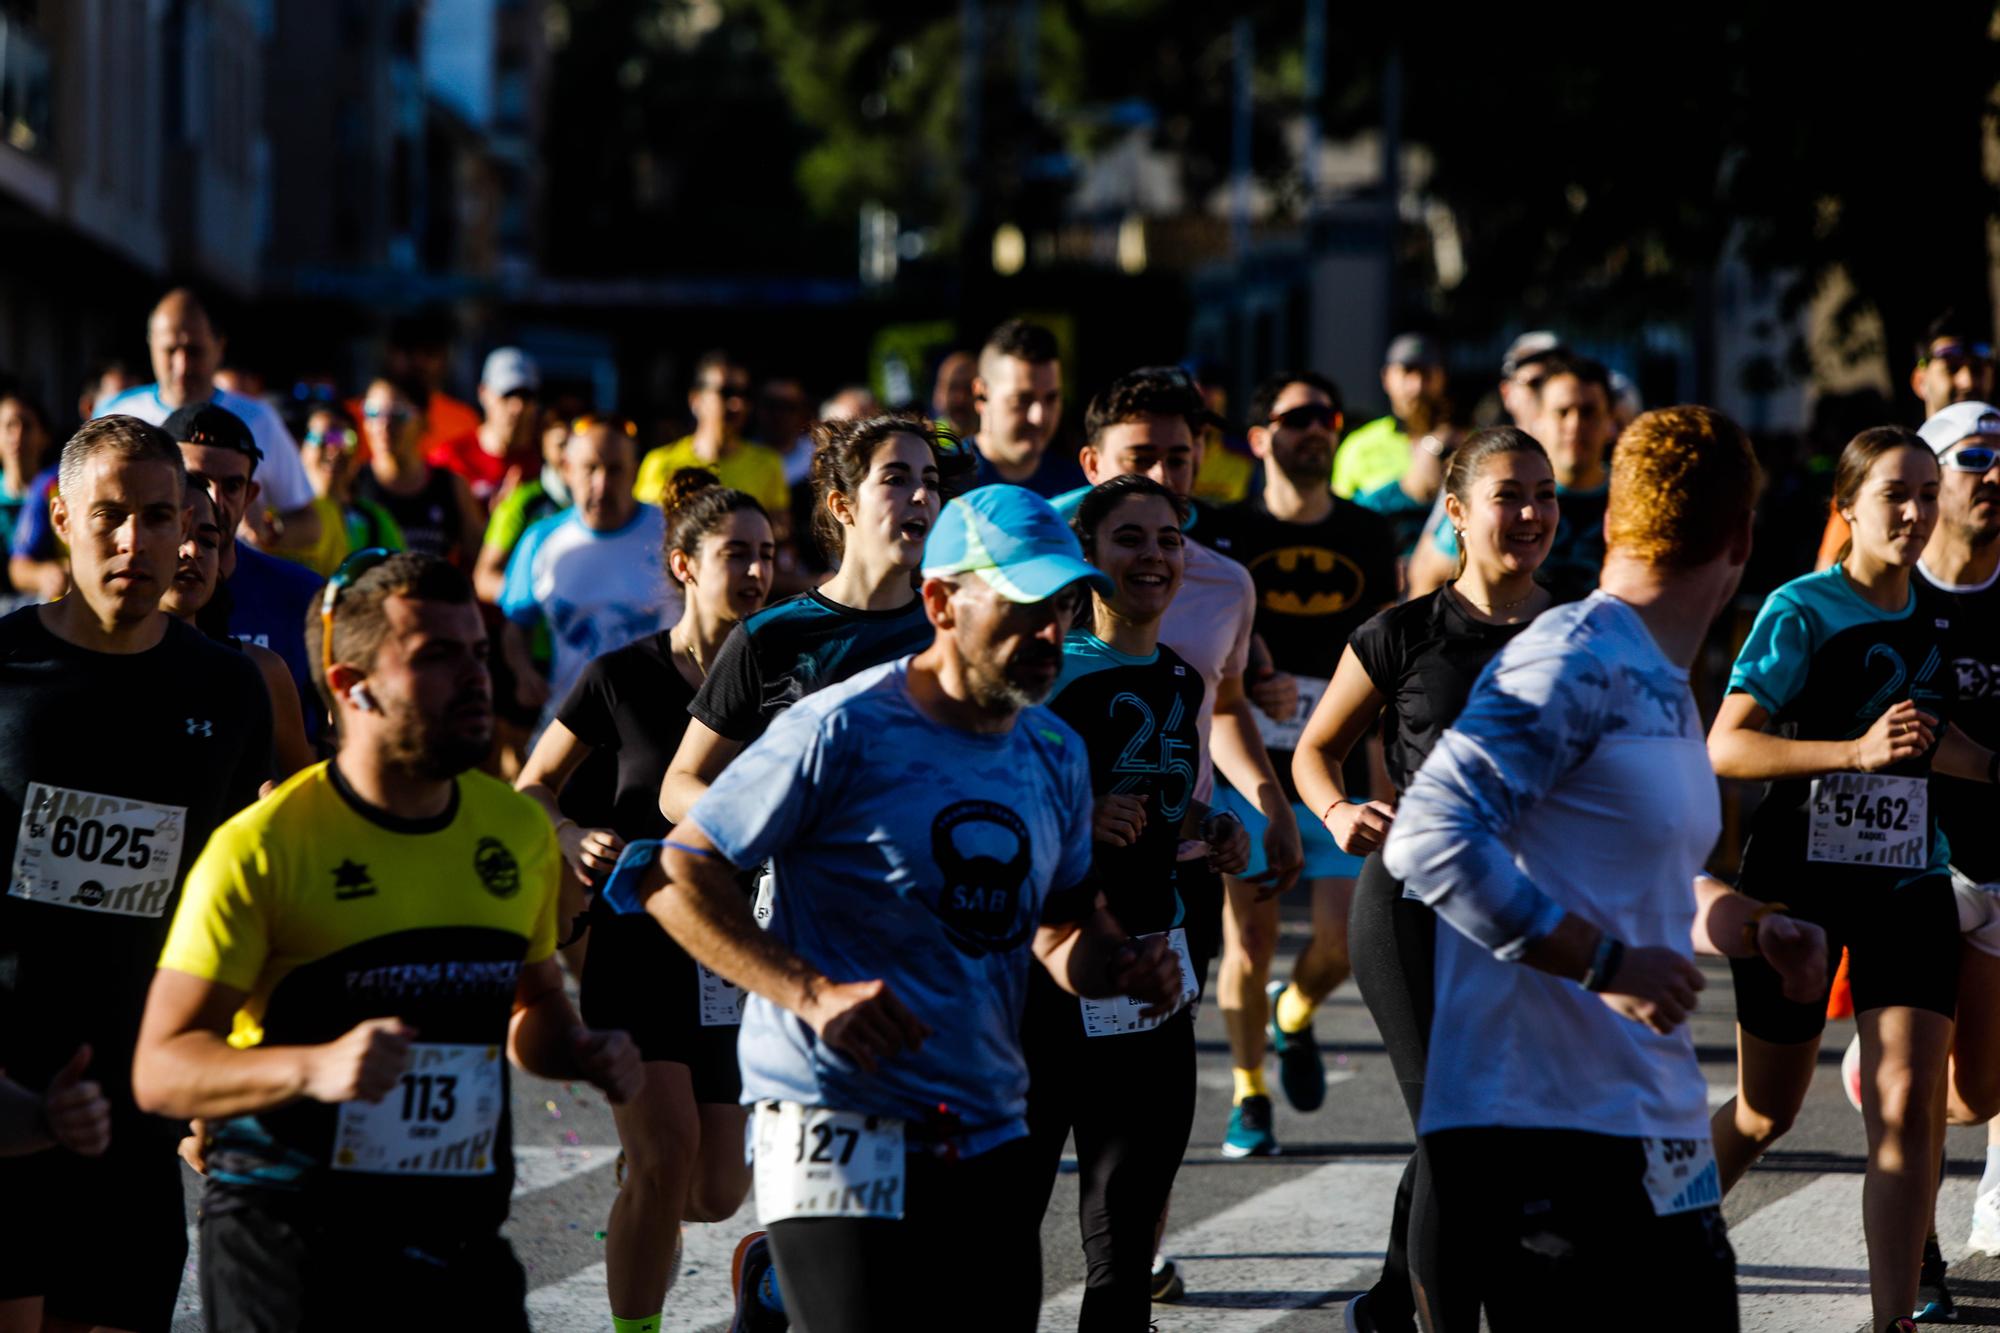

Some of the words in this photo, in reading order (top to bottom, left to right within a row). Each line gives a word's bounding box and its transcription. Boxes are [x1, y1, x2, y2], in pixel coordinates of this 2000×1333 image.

[1109, 691, 1195, 823] 25
[1835, 793, 1908, 831] 5462
[52, 815, 155, 870] 6025
[950, 882, 1010, 914] SAB
[401, 1074, 456, 1122] 113
[796, 1123, 860, 1165] 27
